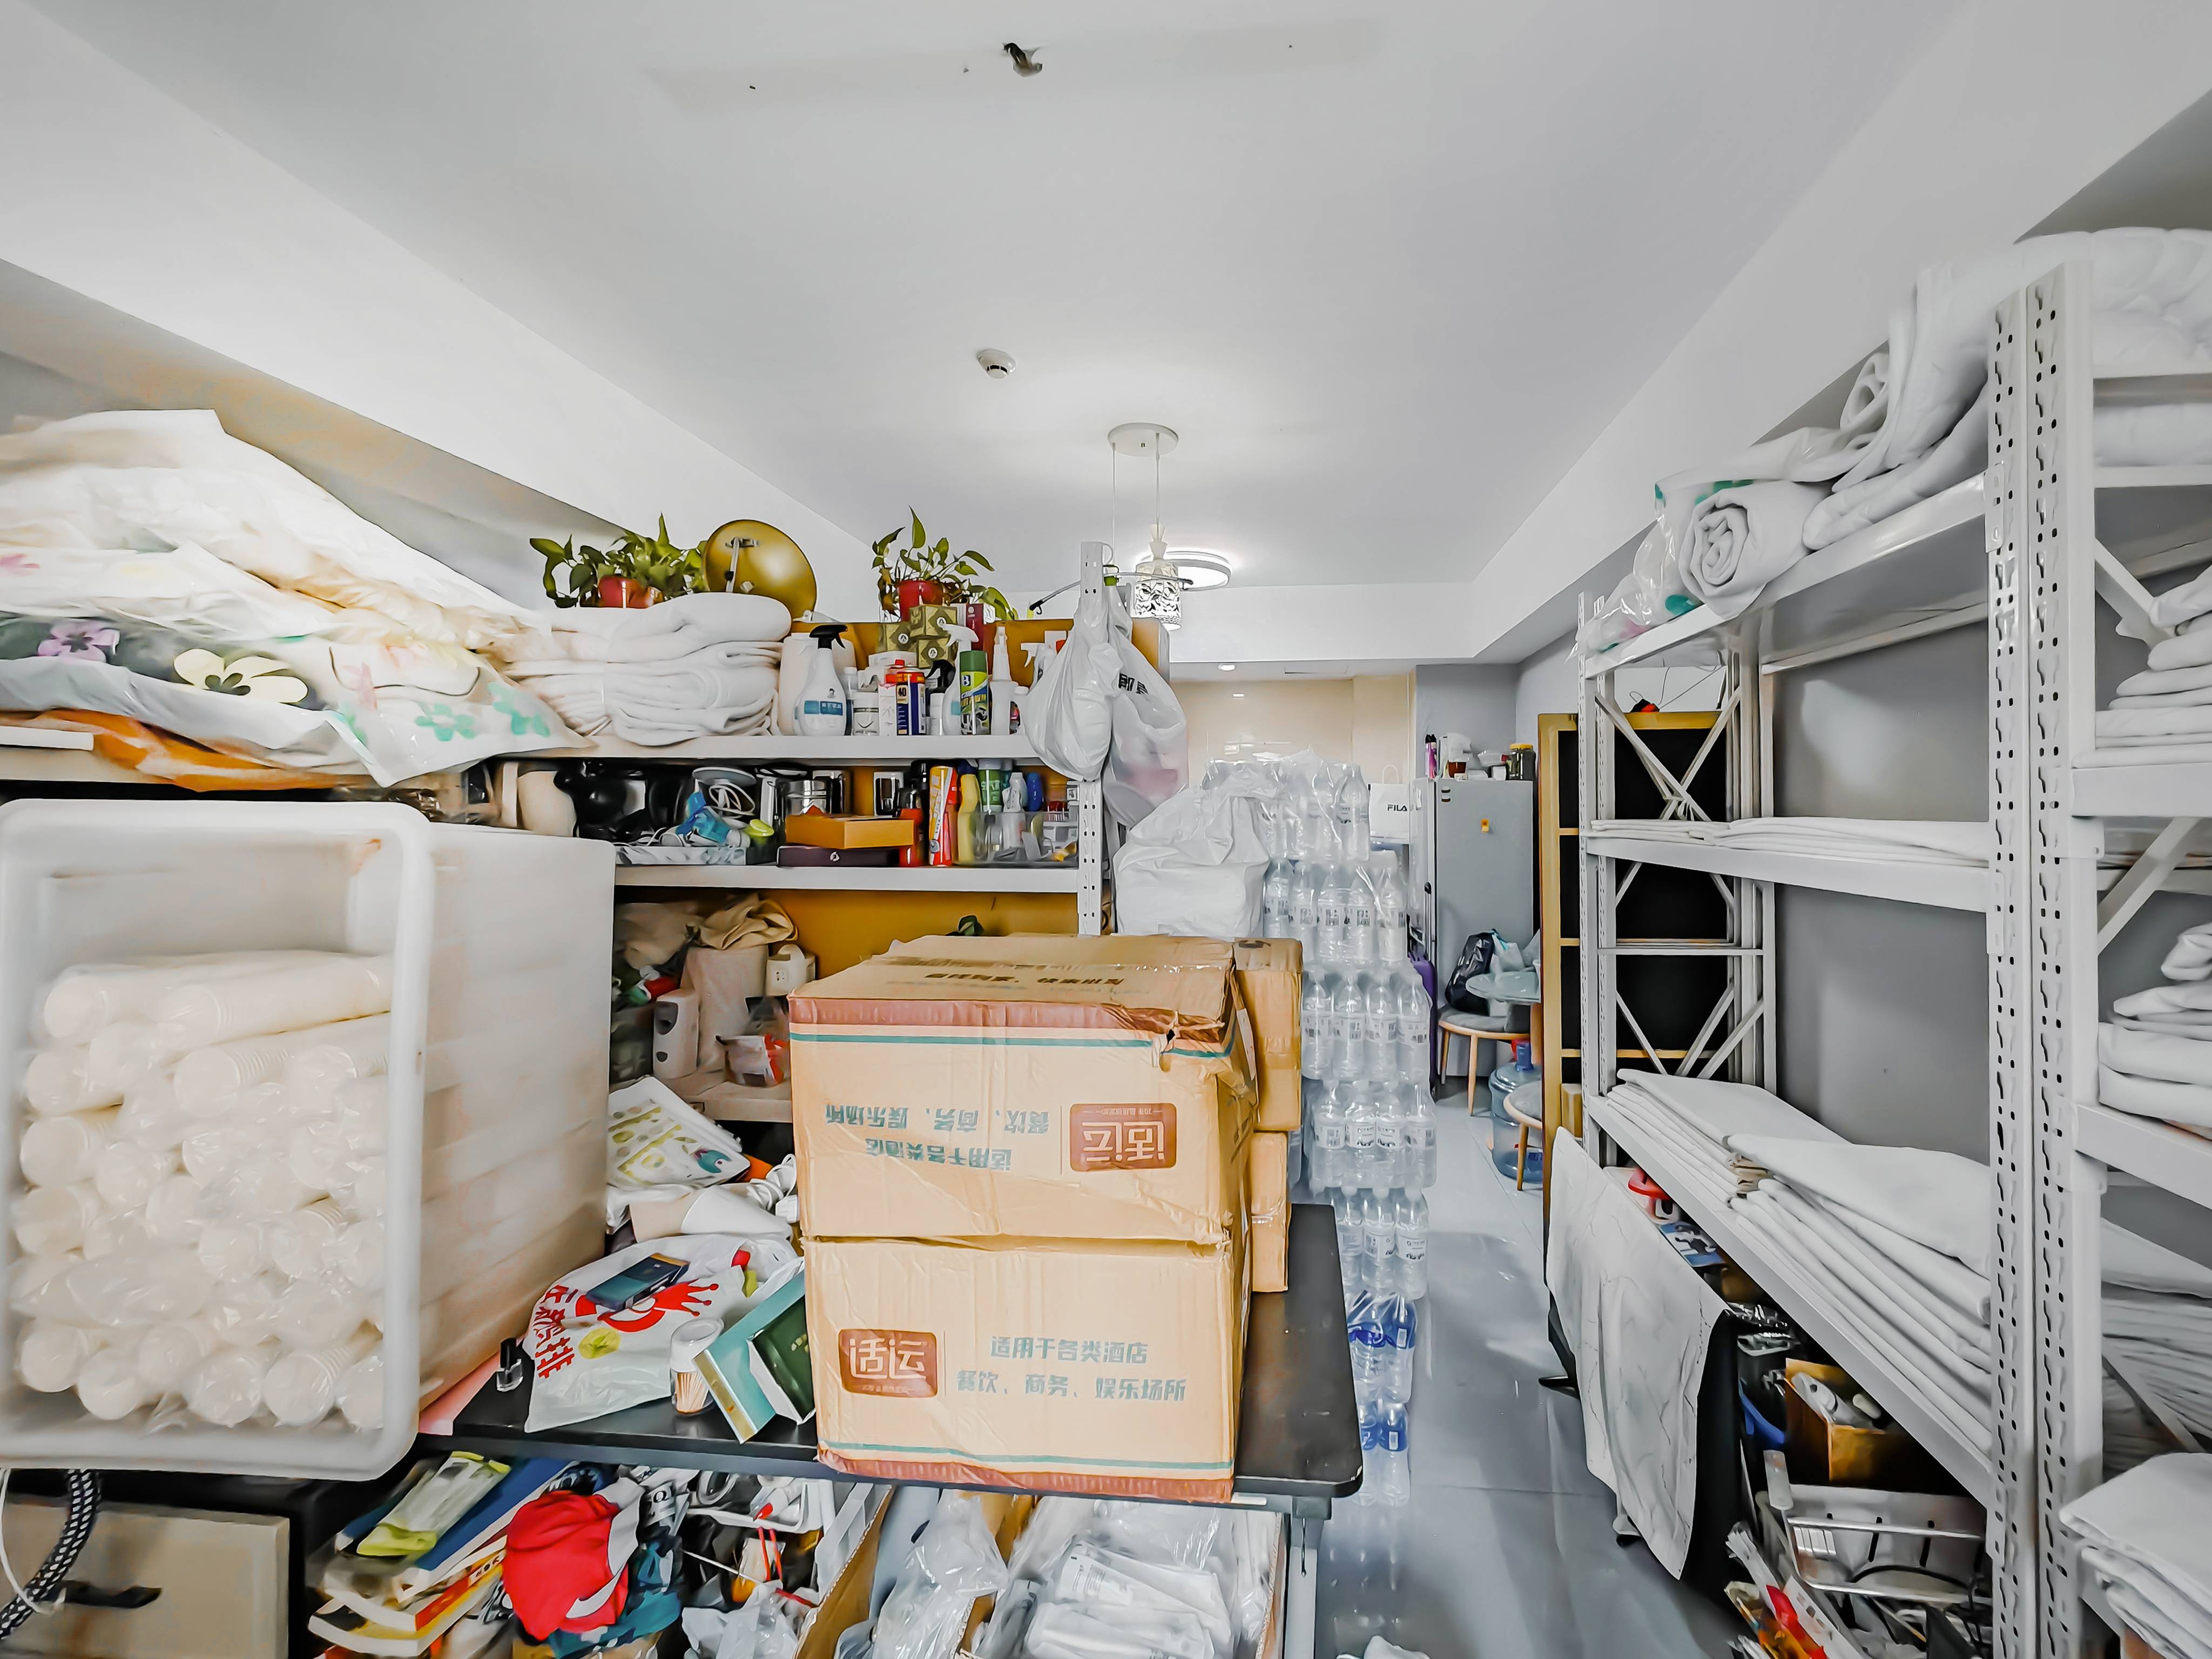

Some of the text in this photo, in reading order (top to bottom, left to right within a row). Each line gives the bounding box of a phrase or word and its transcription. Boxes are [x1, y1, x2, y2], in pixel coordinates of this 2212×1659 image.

[1387, 804, 1408, 812] FILA
[865, 1137, 1013, 1171] 适用于各类酒店
[1082, 1121, 1164, 1161] 适运
[849, 1338, 926, 1380] 适运
[990, 1336, 1149, 1364] 适用于各类酒店
[956, 1370, 1187, 1401] 餐饮、商务、娱乐场所
